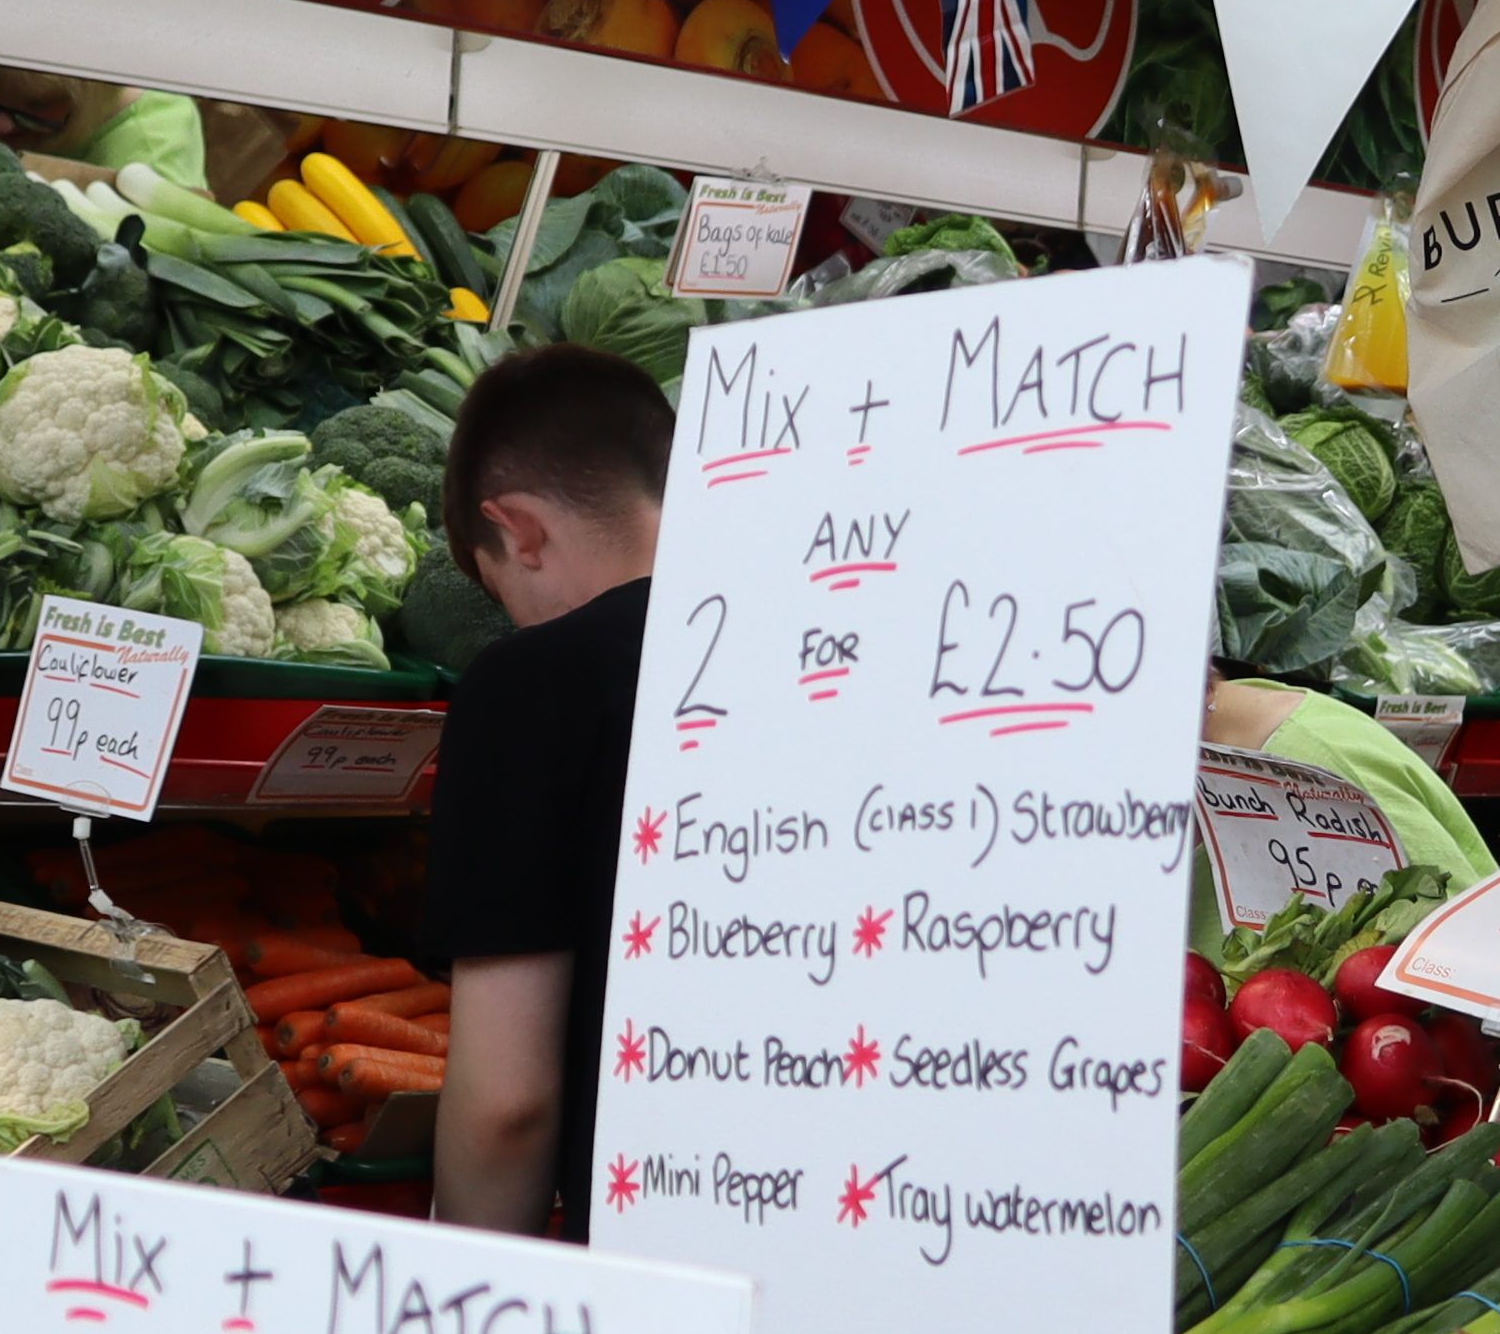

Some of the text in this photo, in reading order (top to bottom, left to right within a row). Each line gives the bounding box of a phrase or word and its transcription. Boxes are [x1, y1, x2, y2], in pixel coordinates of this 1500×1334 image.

[697, 213, 743, 256] Bags
[941, 315, 1189, 433] MATCH
[803, 509, 911, 566] ANY
[43, 606, 167, 650] Fresh is Best
[114, 645, 190, 665] Naturally
[673, 580, 1147, 717] 2 FOR £2.50
[37, 644, 141, 686] Cauliflower
[47, 697, 139, 761] 99p each
[673, 792, 829, 883] English
[1198, 774, 1385, 844] Bunch Radish
[1268, 837, 1343, 909] 95p
[666, 890, 1118, 986] Blueberry Raspberry
[646, 1027, 1168, 1122] Donut Peach Seedless Grapes
[641, 1152, 1163, 1266] Mini Pepper Tray watermelon
